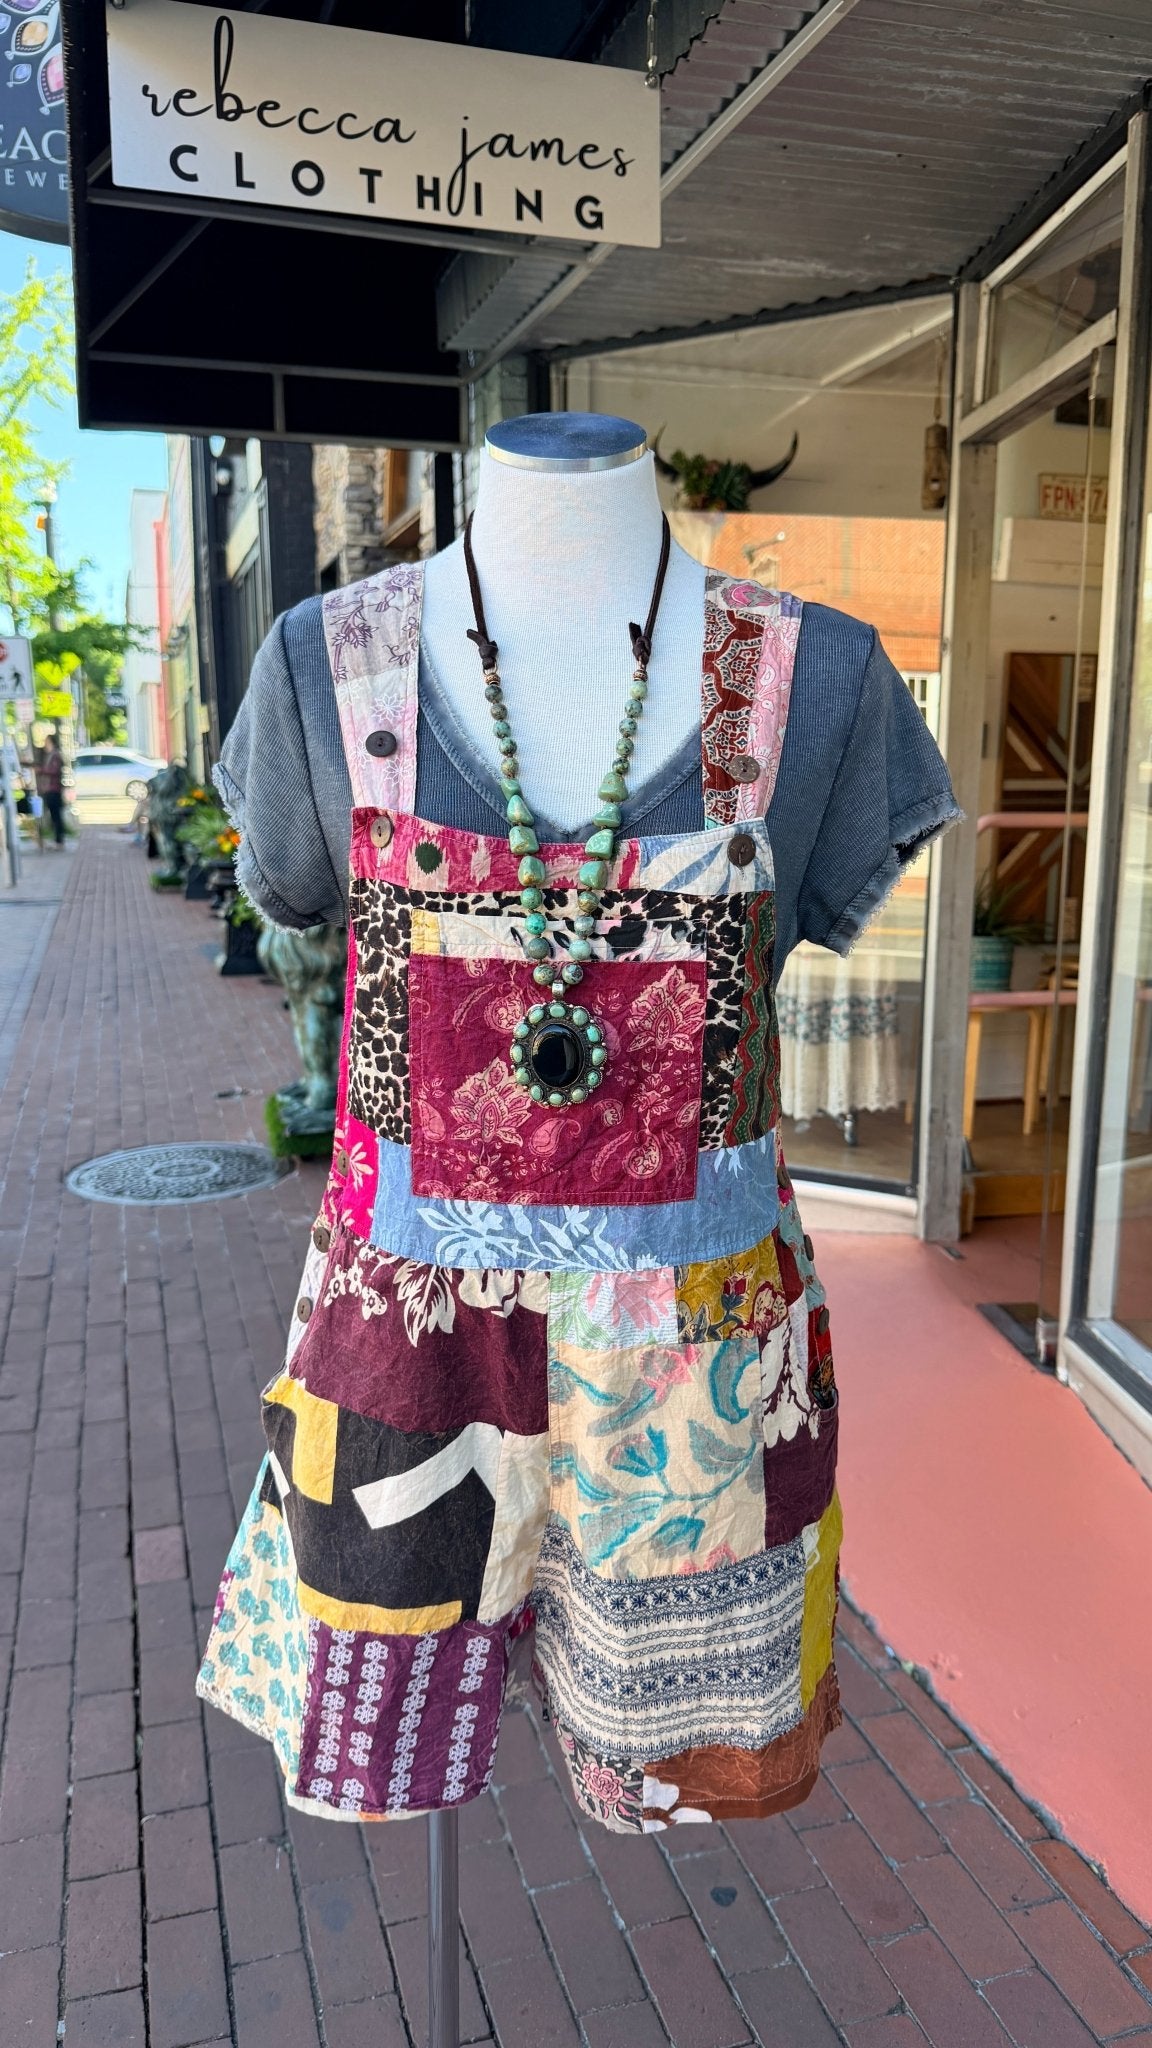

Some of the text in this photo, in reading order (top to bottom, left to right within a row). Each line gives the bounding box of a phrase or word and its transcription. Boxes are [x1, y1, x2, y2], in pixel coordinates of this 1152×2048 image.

[141, 16, 634, 216] rebecca james
[169, 145, 604, 230] CLOTHING
